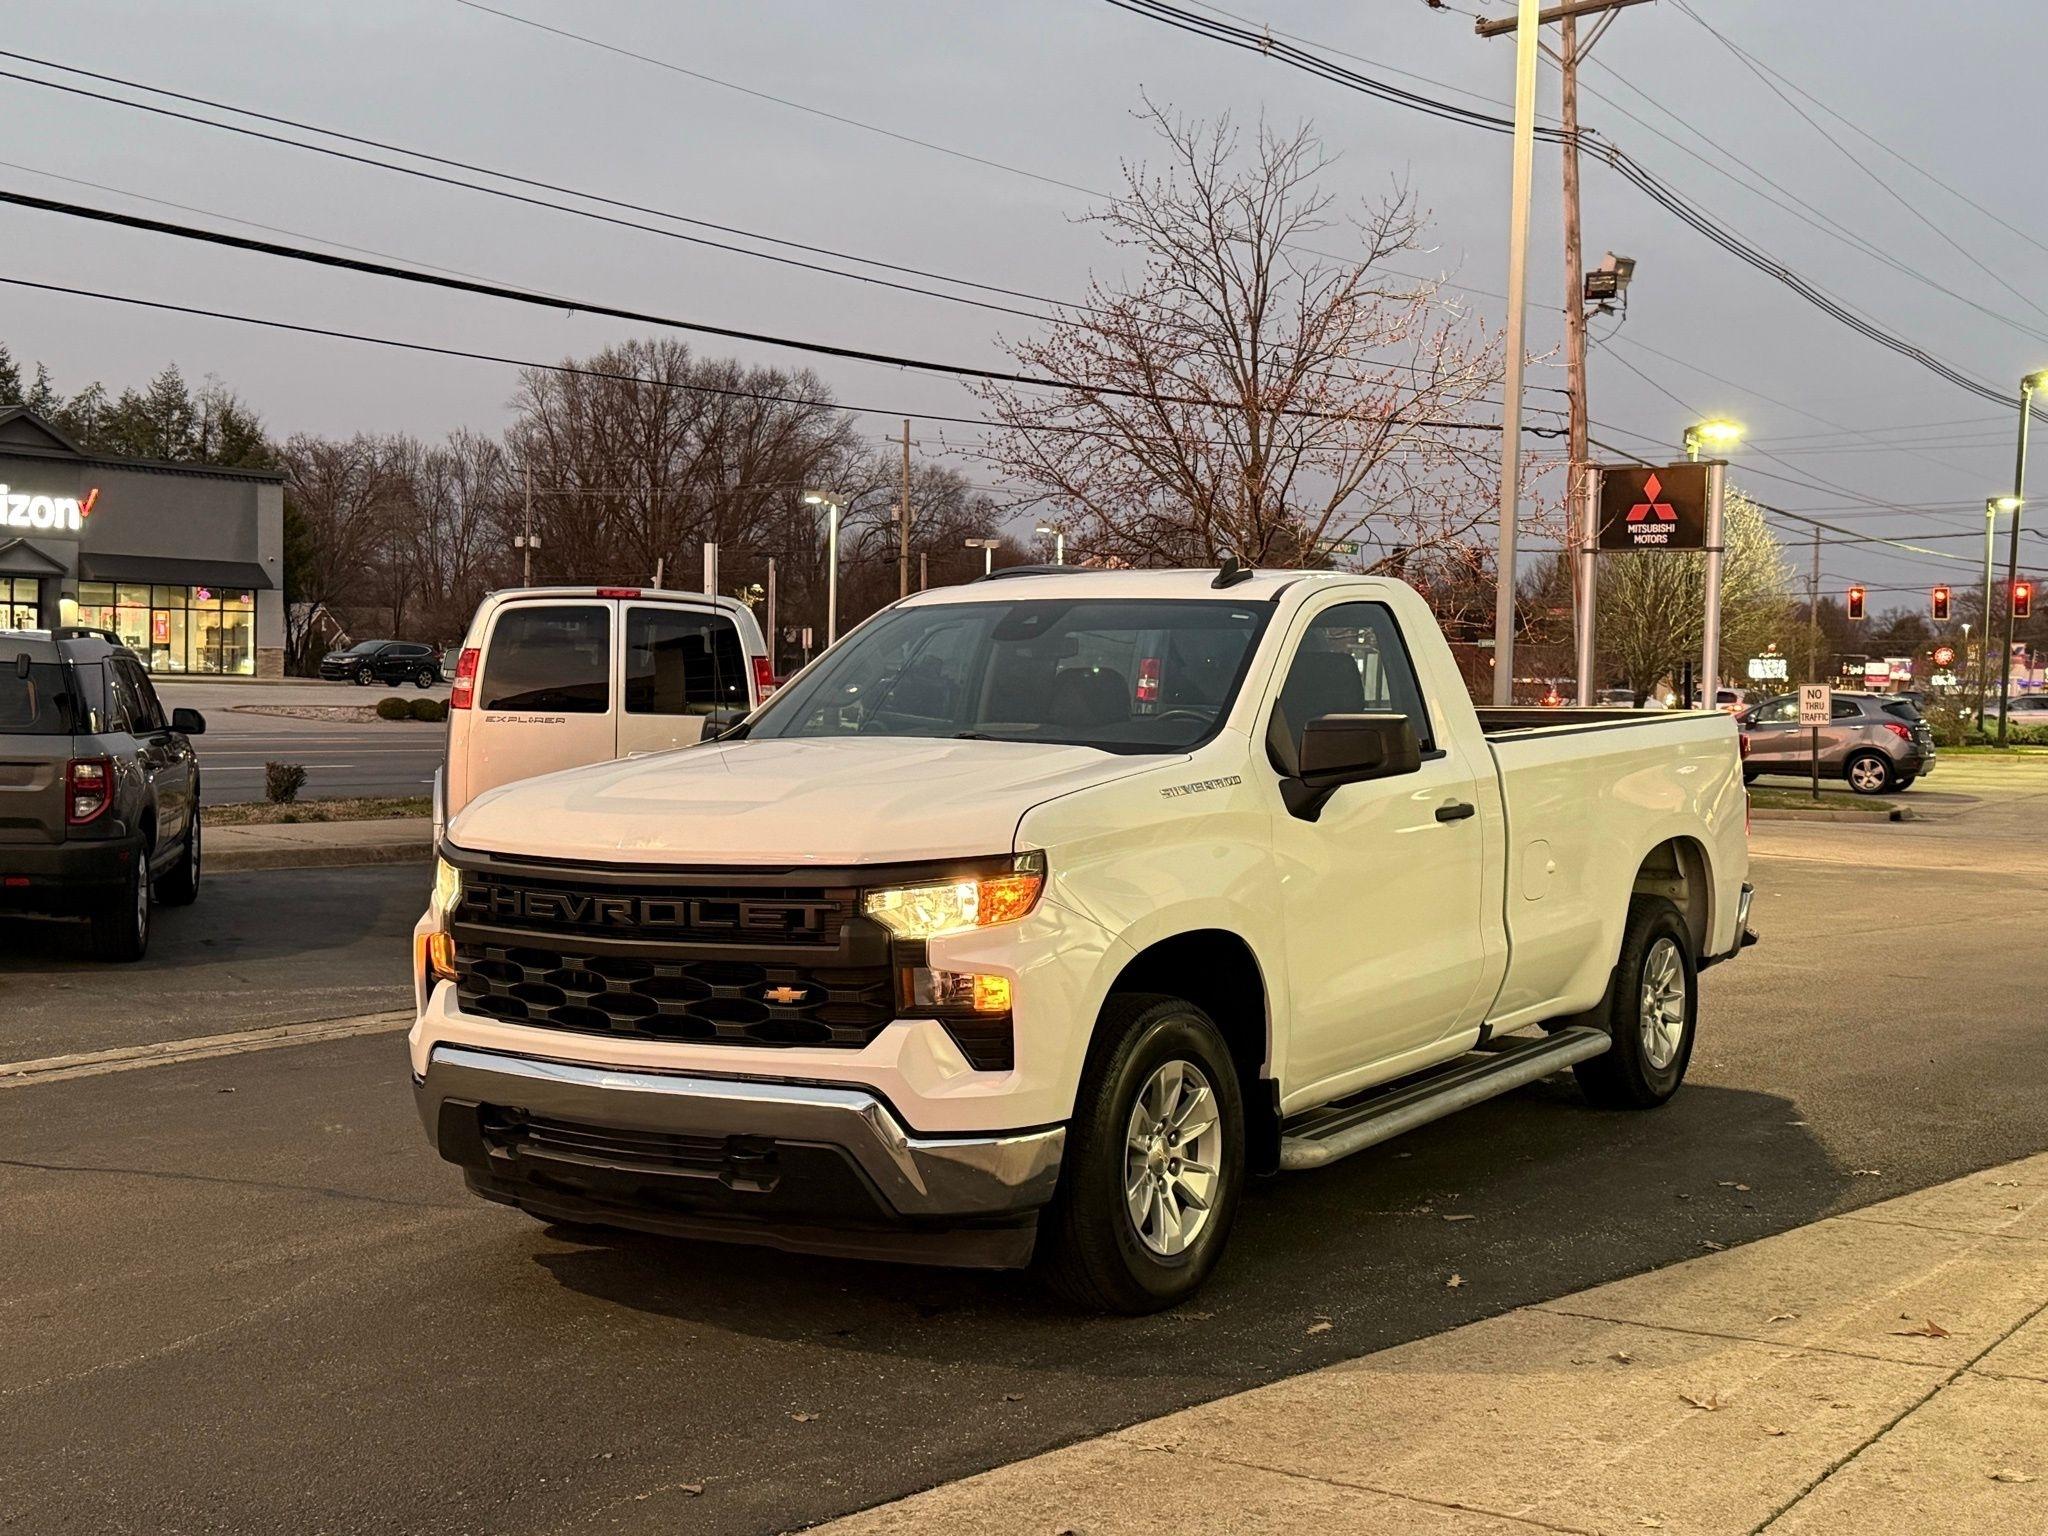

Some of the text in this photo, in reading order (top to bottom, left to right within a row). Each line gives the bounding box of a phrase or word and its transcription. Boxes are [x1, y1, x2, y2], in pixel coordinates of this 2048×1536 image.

[1627, 523, 1676, 534] MITSUBISHI
[1633, 534, 1668, 544] MOTORS
[1807, 689, 1822, 699] NO
[1805, 701, 1825, 710] THRU
[1801, 712, 1829, 721] TRAFFIC
[1160, 775, 1242, 799] SILVERADO
[462, 883, 842, 931] CHEVROLET
